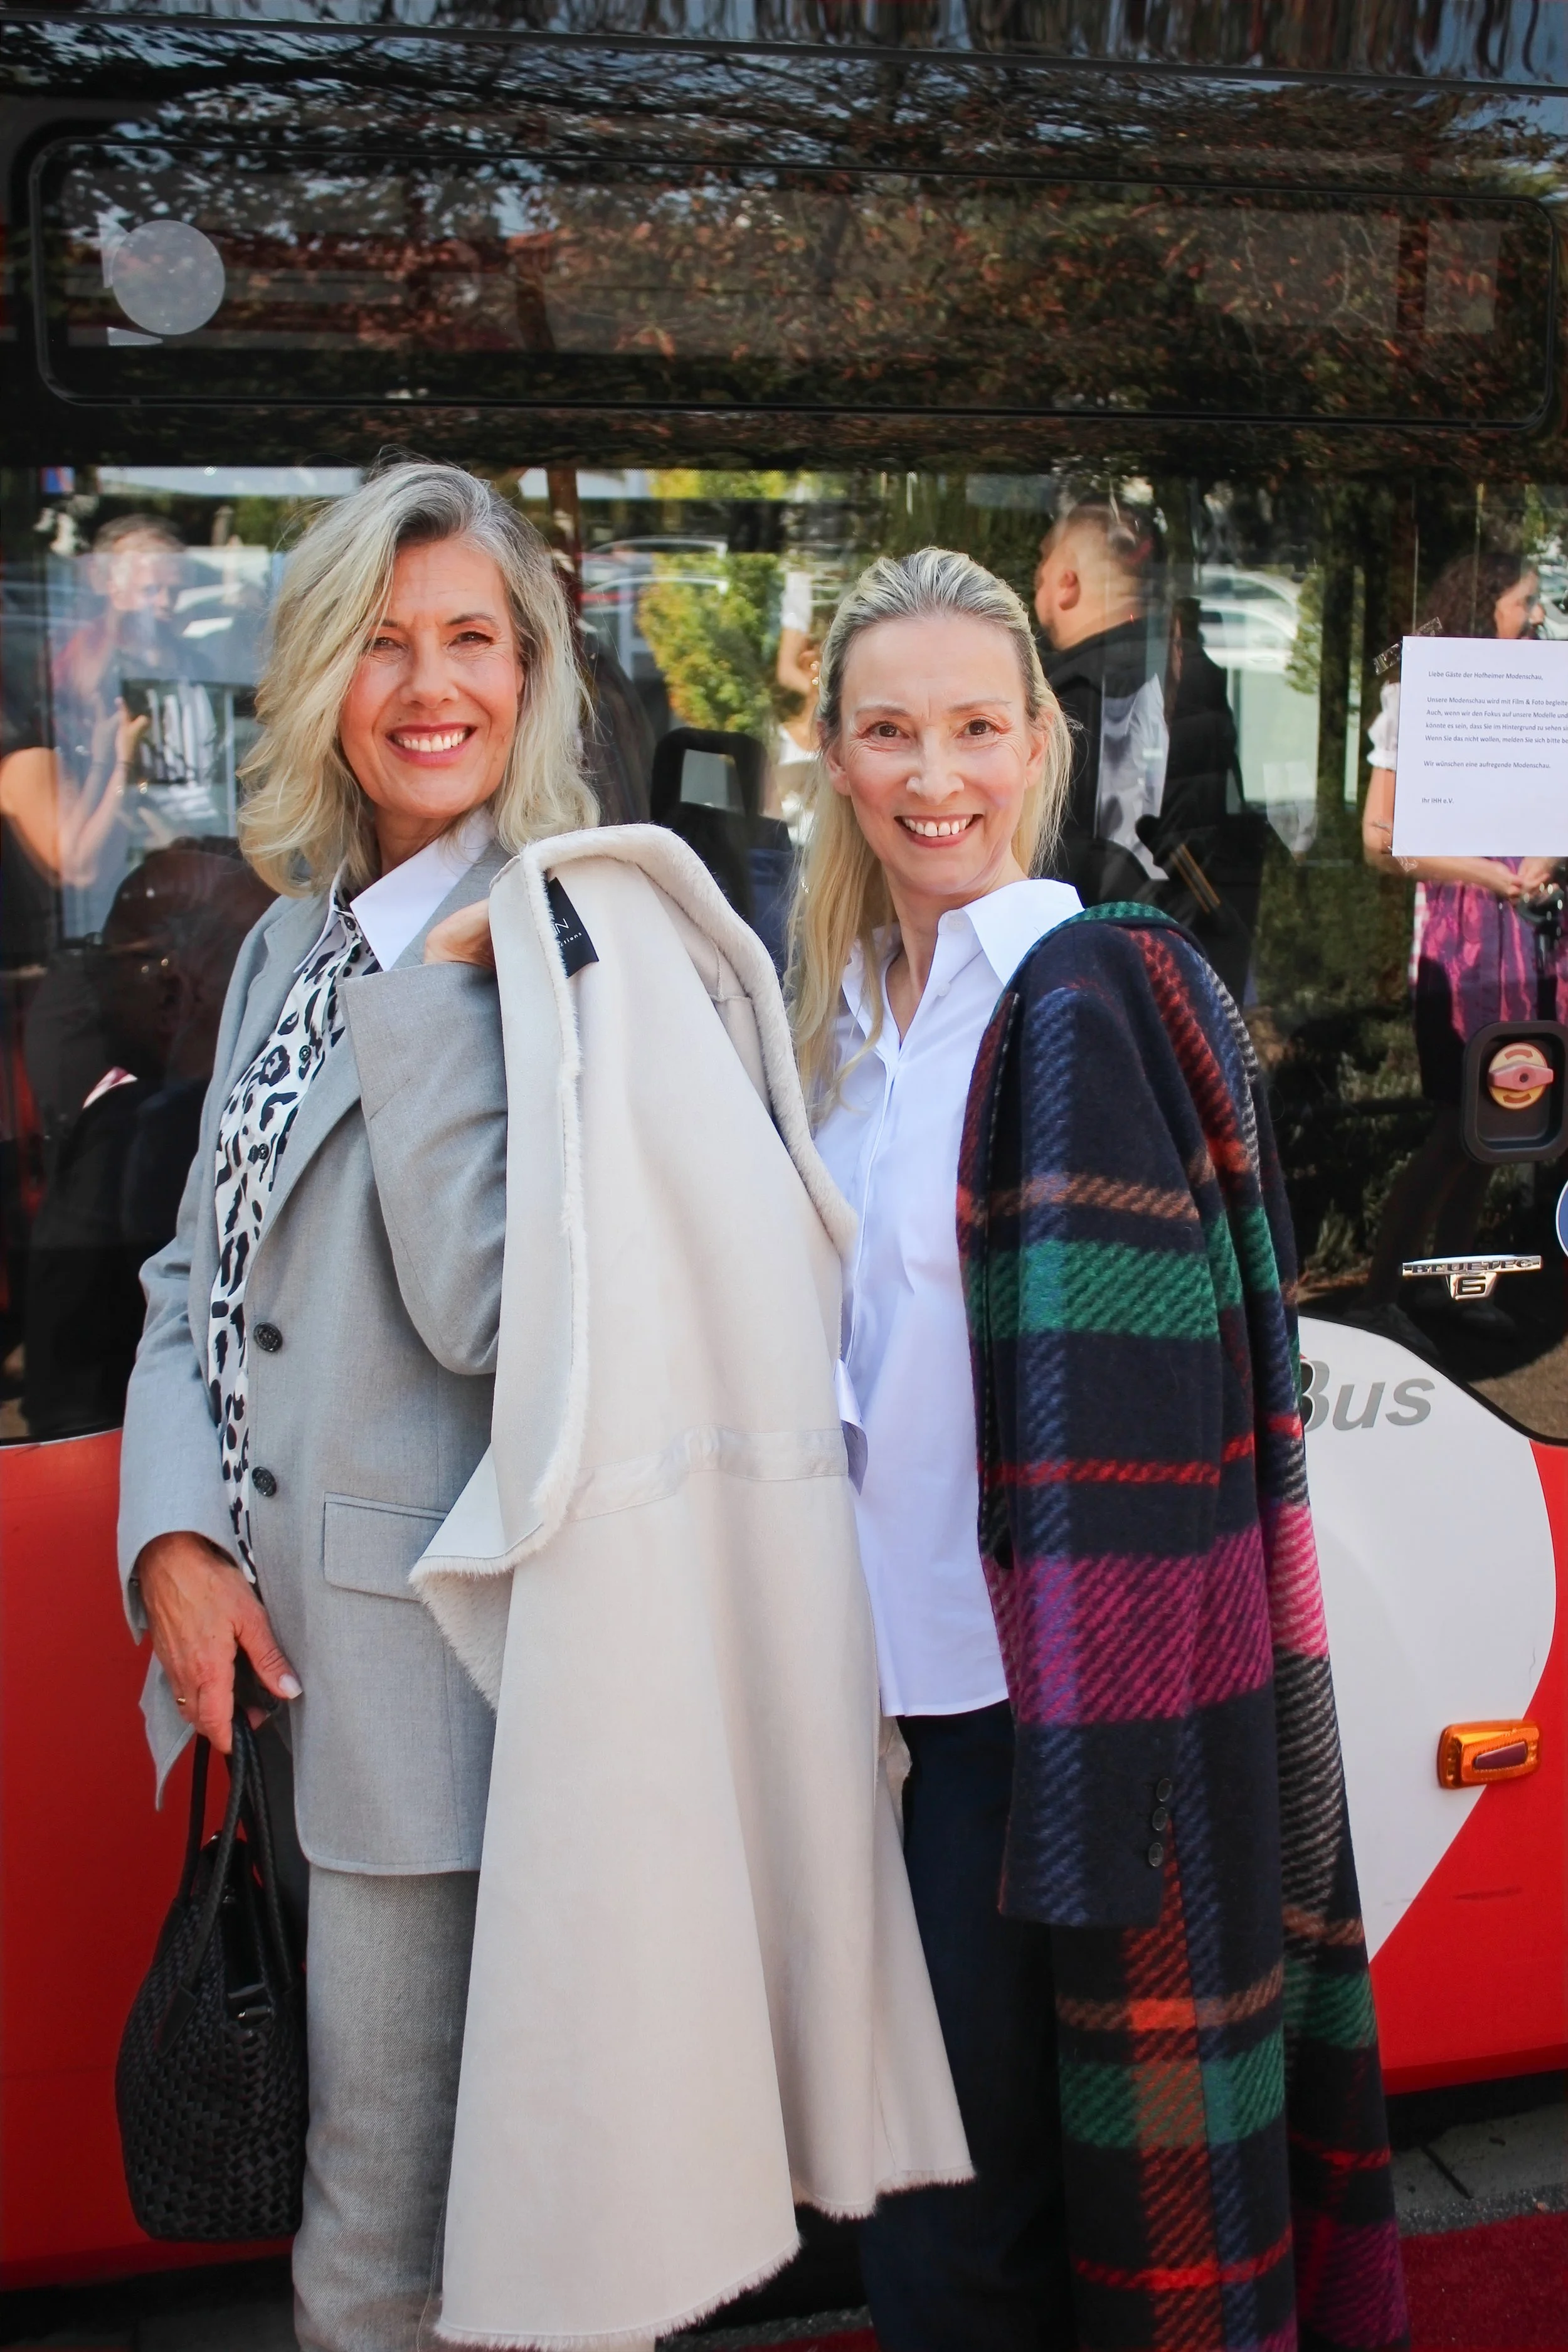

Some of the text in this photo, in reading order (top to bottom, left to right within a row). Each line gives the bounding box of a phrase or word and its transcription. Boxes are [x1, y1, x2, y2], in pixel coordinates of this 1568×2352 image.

[1505, 672, 1544, 681] Modenschau,
[1545, 699, 1568, 707] begleite
[1502, 724, 1537, 732] Hintergrund
[1478, 761, 1512, 769] aufregende
[1411, 1258, 1535, 1274] BLUETEC
[1456, 1275, 1488, 1295] 6
